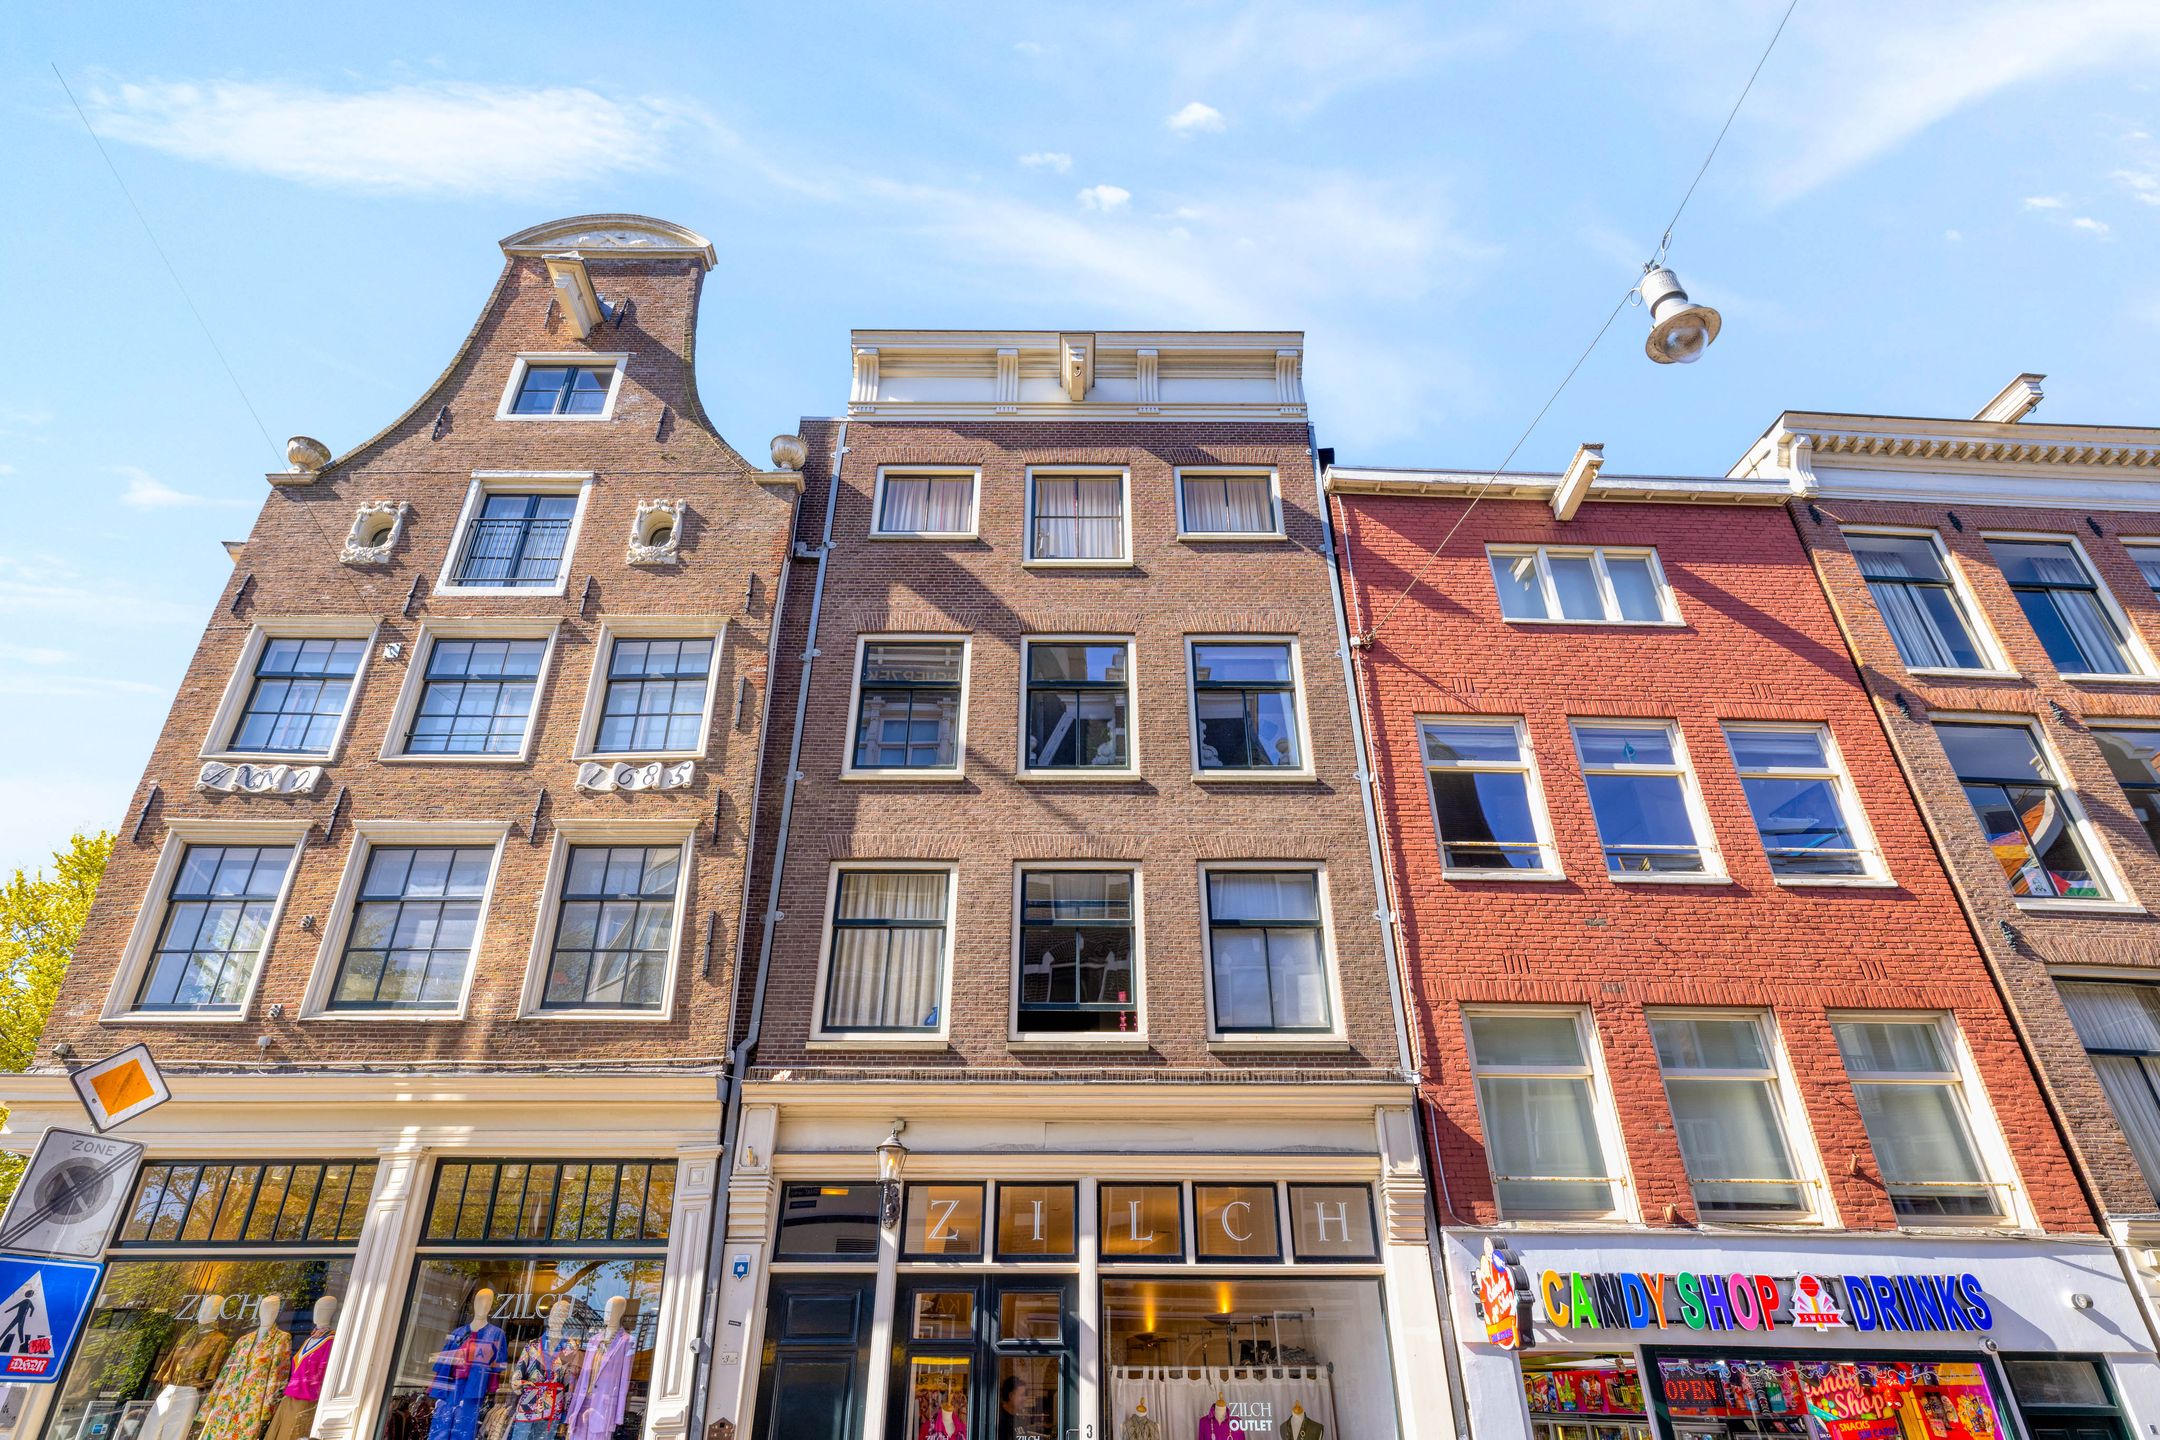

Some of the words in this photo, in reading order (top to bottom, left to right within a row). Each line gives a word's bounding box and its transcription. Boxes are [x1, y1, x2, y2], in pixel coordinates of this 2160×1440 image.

[201, 765, 311, 789] ANNO
[587, 763, 691, 786] 1685
[71, 1140, 117, 1157] ZONE
[173, 1294, 265, 1321] ZILCH
[491, 1293, 577, 1319] ZILCH
[1540, 1268, 1668, 1330] CANDY
[1676, 1270, 1781, 1332] SHOP
[1842, 1272, 1994, 1332] DRINKS
[1664, 1380, 1717, 1400] OPEN
[1229, 1402, 1272, 1417] ZILCH
[1834, 1390, 1885, 1419] Shop
[1086, 1424, 1093, 1438] 3
[1229, 1419, 1273, 1431] OUTLET
[1839, 1420, 1871, 1432] SNACKS
